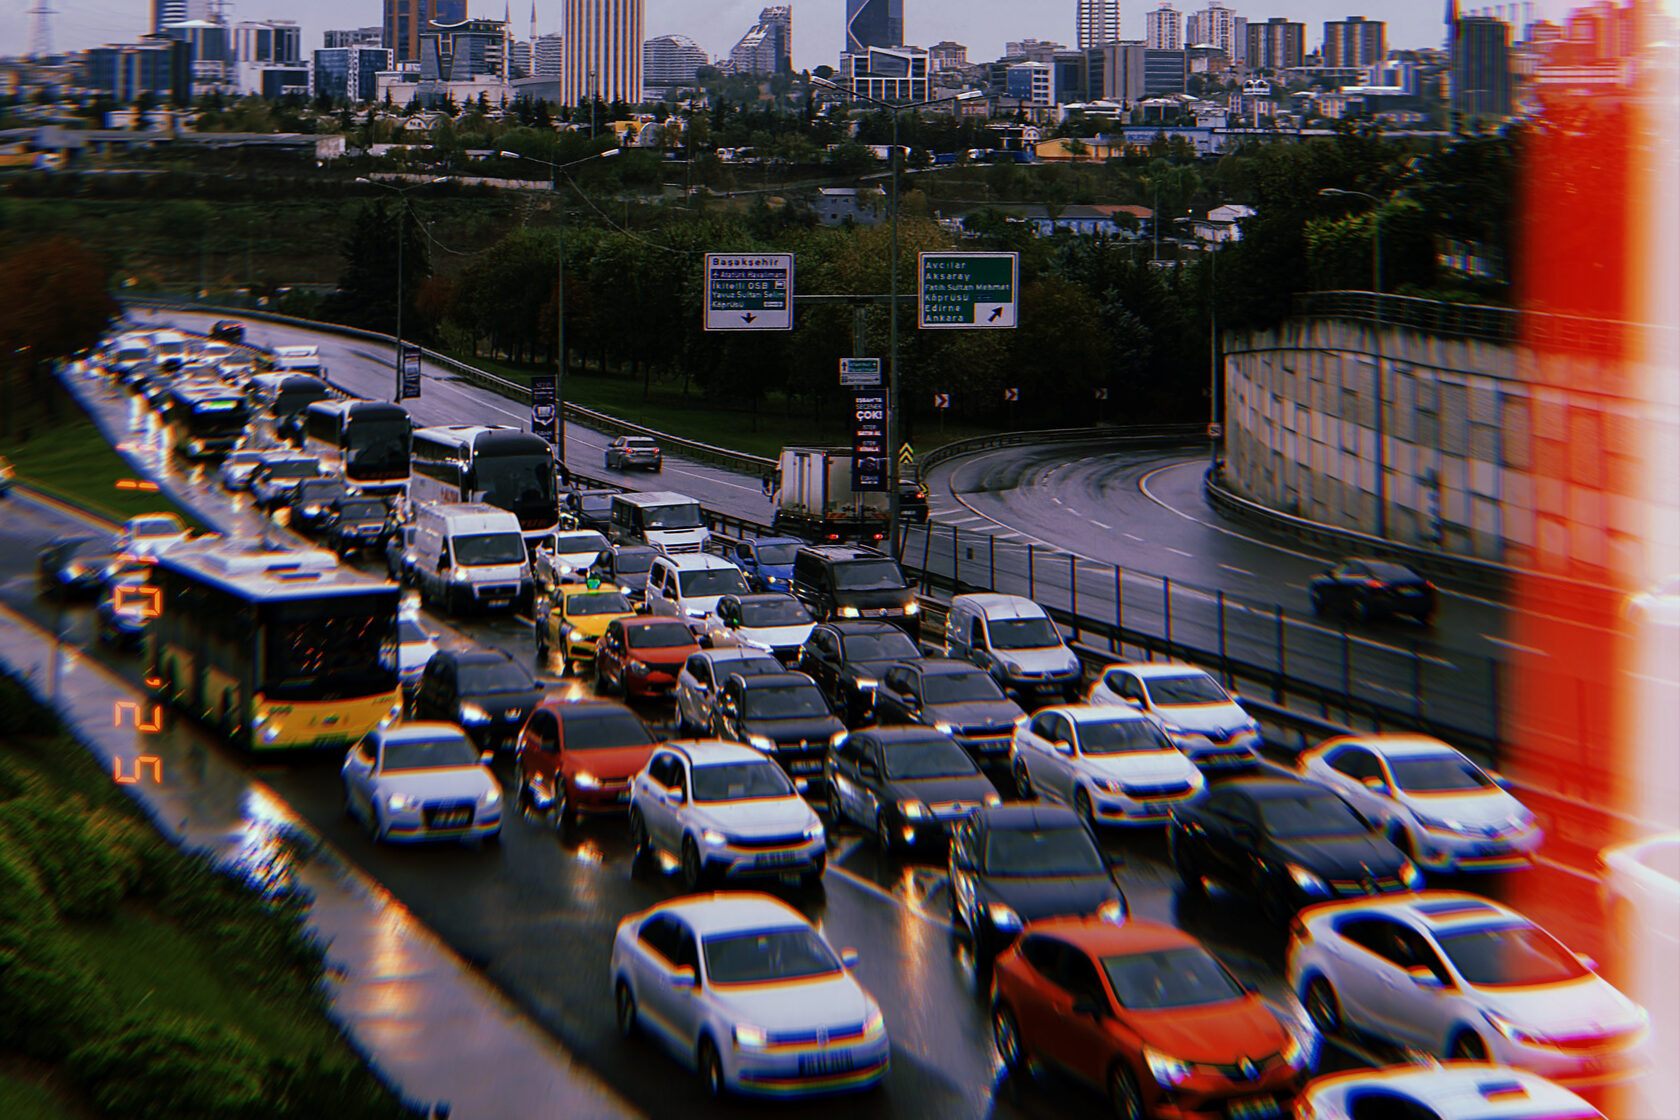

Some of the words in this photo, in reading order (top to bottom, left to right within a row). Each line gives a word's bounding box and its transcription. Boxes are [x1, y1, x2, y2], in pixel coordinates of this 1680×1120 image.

[712, 257, 780, 267] Başakşehir
[925, 261, 967, 269] Avcılar
[925, 272, 971, 281] Aksaray
[748, 282, 769, 290] OSB
[737, 290, 762, 298] Sultan
[925, 293, 970, 302] Köprüsü
[925, 304, 962, 312] Edirne
[925, 314, 965, 322] Ankara
